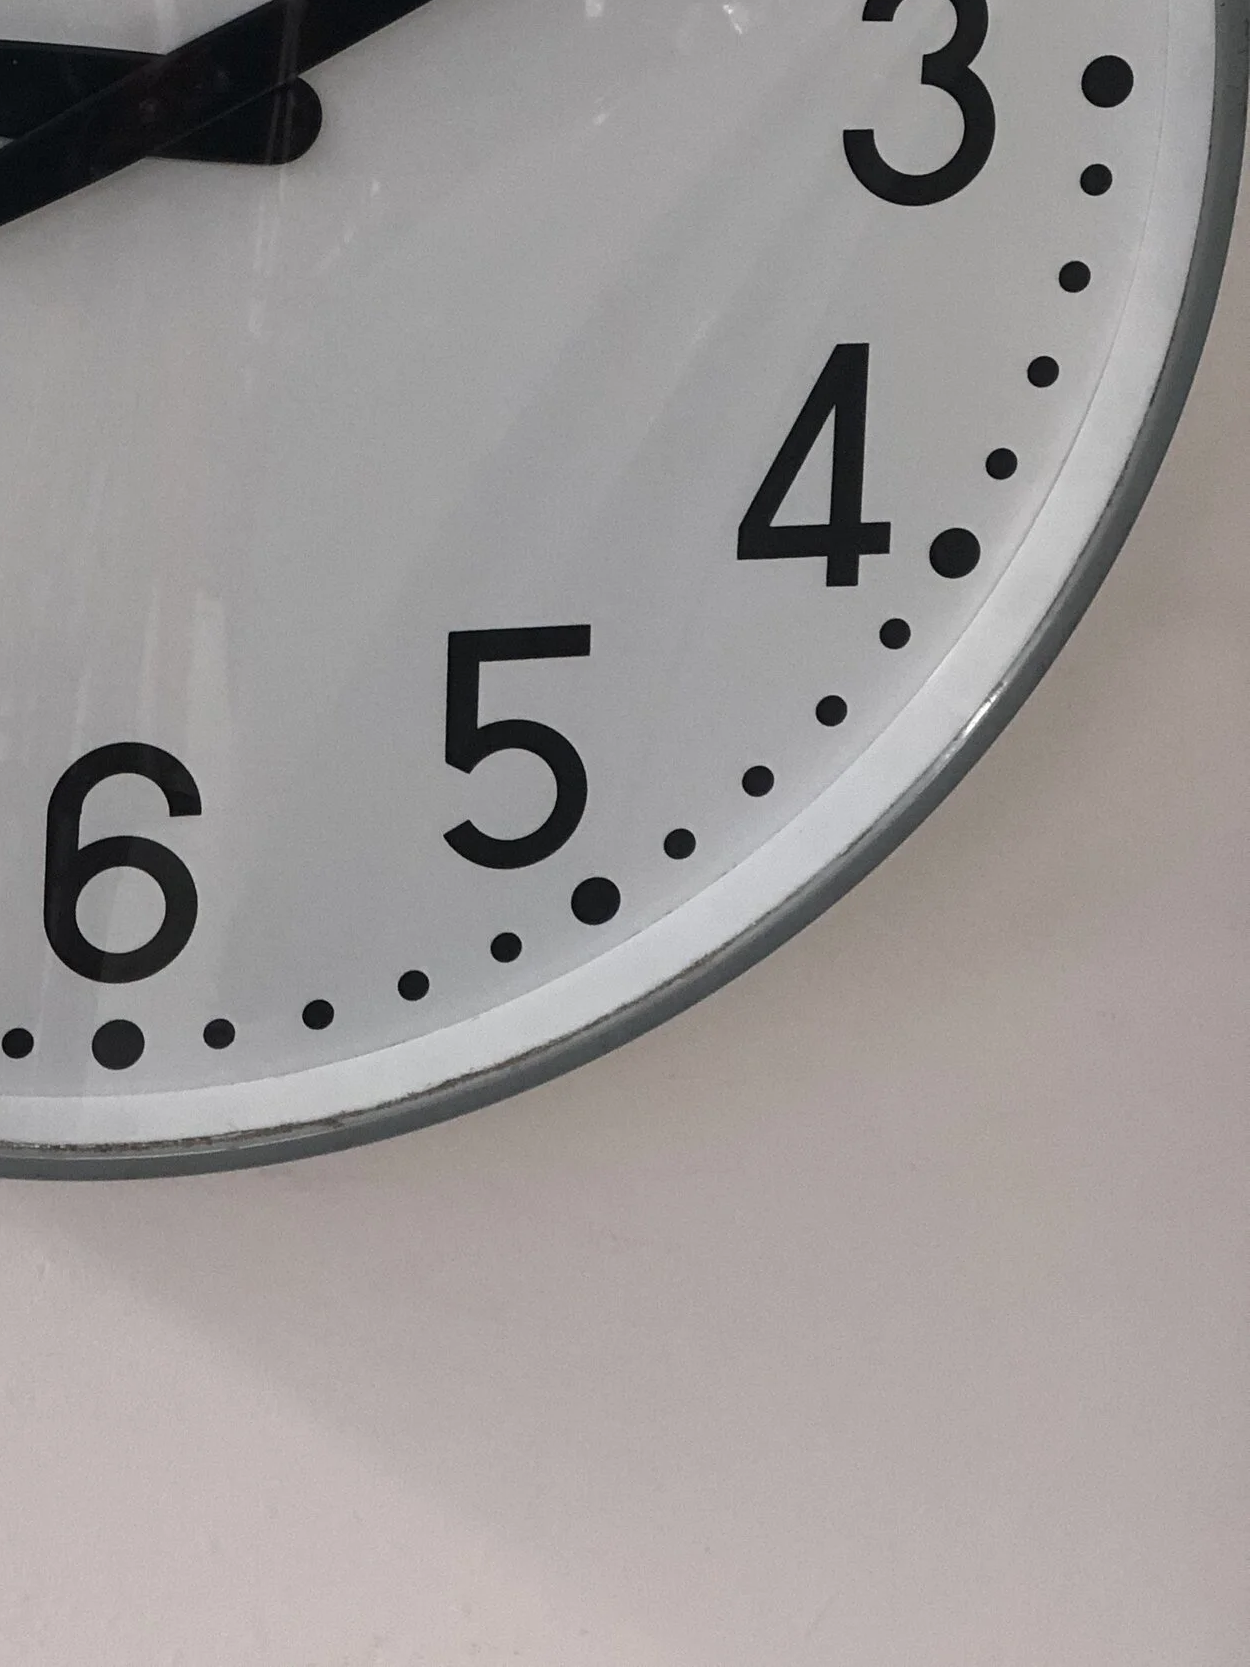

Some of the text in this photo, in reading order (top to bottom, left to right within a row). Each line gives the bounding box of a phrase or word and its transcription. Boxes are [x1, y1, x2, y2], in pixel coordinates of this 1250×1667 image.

[736, 342, 893, 589] 4
[42, 741, 204, 985] 6
[442, 623, 592, 871] 5
